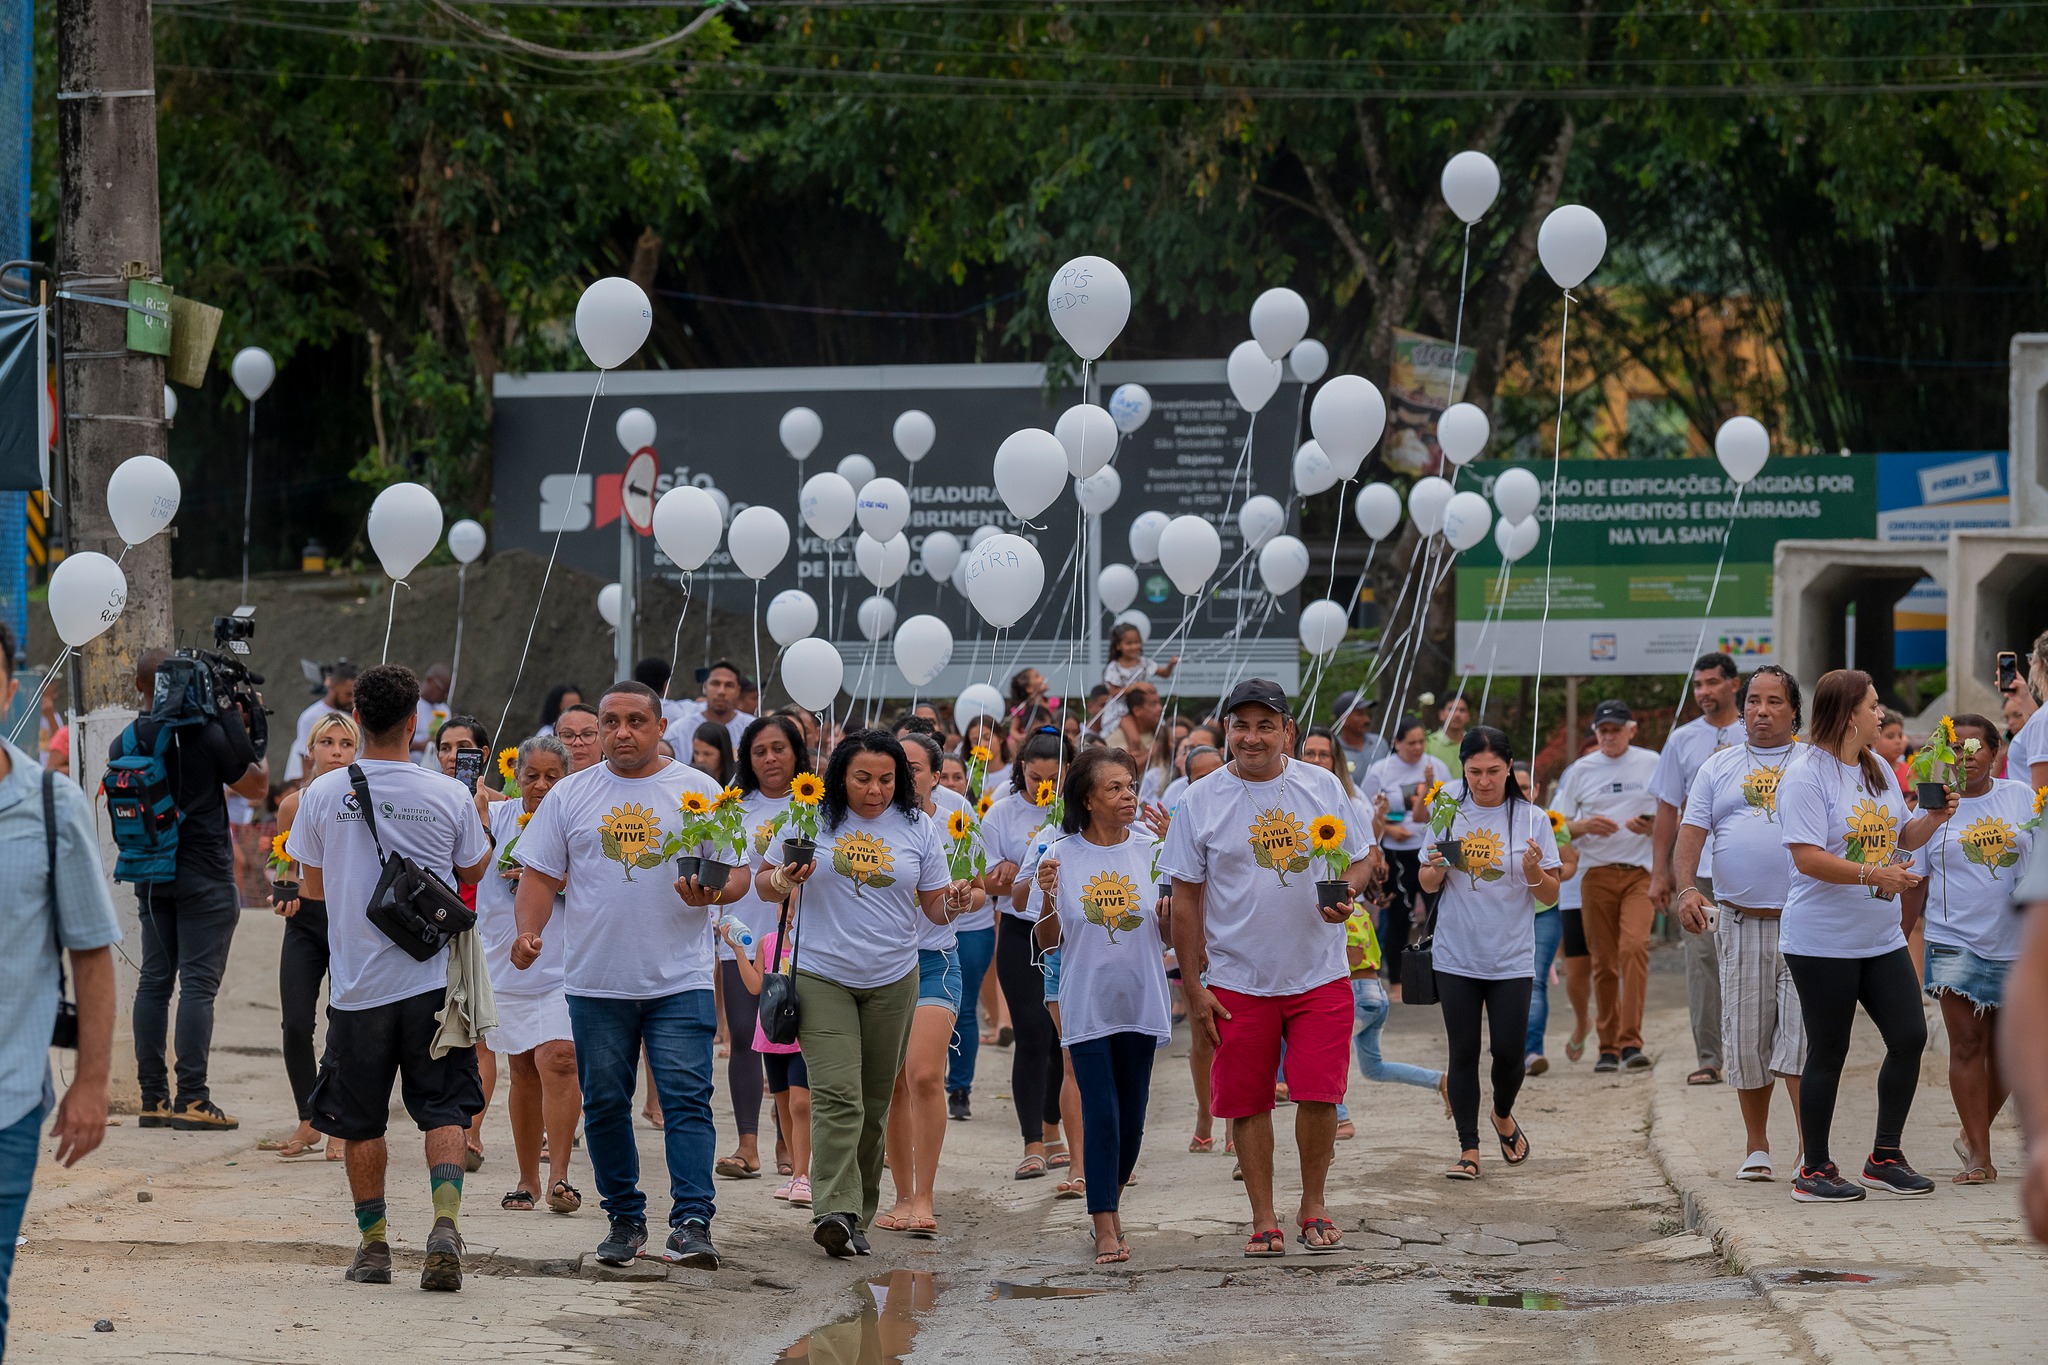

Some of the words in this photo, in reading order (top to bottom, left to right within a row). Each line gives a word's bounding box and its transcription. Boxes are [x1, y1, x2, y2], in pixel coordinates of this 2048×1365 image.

[1584, 479, 1608, 497] DE
[1610, 473, 1722, 499] EDIFICAÇÕES
[1723, 474, 1815, 494] AINGIDAS
[1817, 474, 1855, 493] POR
[1536, 502, 1687, 522] CORREGAMENTOS
[1690, 502, 1702, 519] E
[1704, 500, 1821, 519] ENXURRADAS
[1609, 527, 1635, 545] NA
[1636, 526, 1676, 545] VILA
[1678, 526, 1726, 544] SAHY
[798, 560, 824, 578] DE
[401, 807, 430, 815] INSTITUTO
[393, 813, 437, 823] VERDESCOLA
[616, 822, 623, 830] A
[1863, 824, 1868, 833] A
[1868, 823, 1885, 832] VLA
[614, 831, 646, 843] VIVE
[1270, 827, 1289, 837] VILA
[1981, 828, 1999, 836] VILA
[1262, 836, 1293, 850] VIVE
[1973, 834, 2003, 848] VIVE
[857, 846, 876, 854] VILA
[1464, 849, 1491, 859] VIVE
[846, 851, 879, 864] VIVE
[1094, 896, 1126, 907] VIVE
